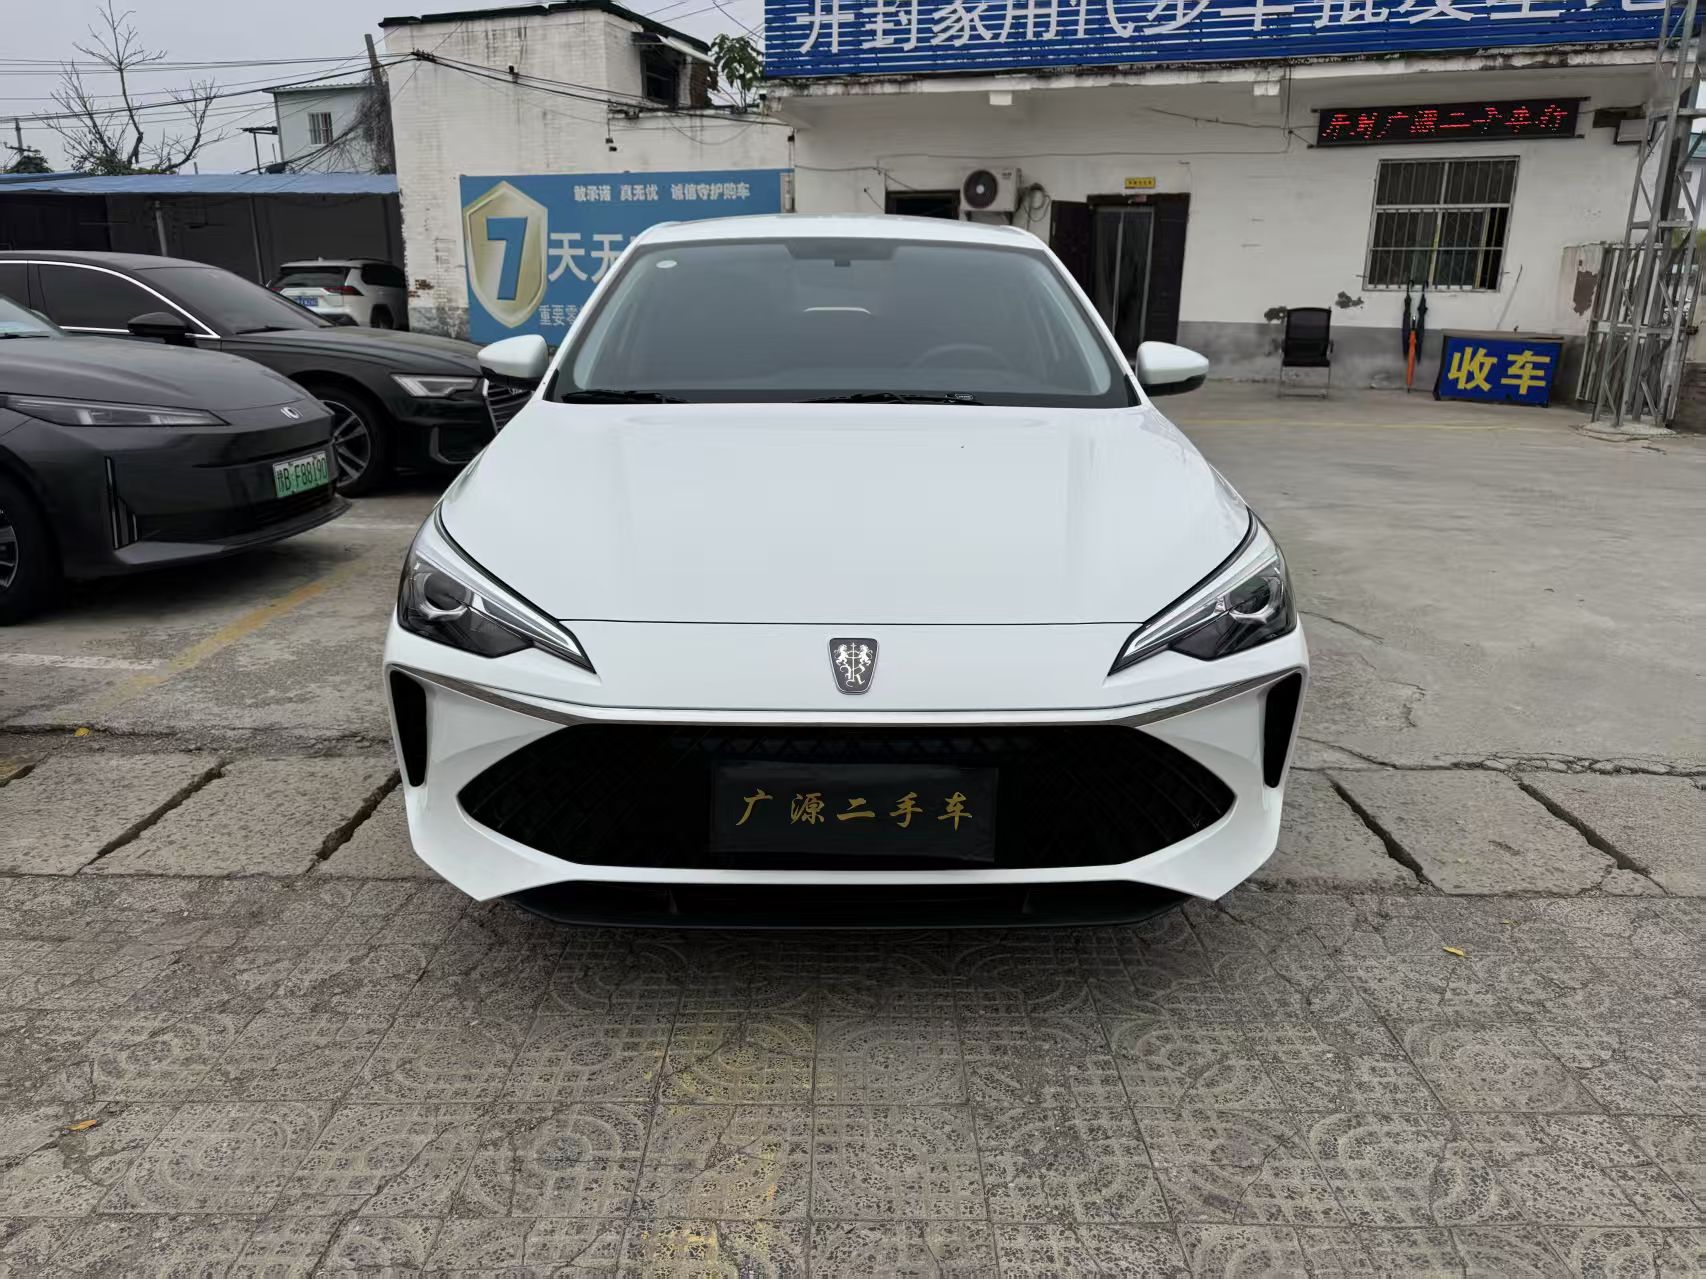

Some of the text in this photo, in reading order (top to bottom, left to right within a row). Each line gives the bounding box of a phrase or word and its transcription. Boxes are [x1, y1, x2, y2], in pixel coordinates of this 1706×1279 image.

[620, 184, 659, 201] 真无忧
[671, 181, 751, 201] 诚信守护购车
[538, 304, 584, 327] 重要零
[1447, 346, 1552, 395] 收车
[735, 787, 973, 831] 广源二手车
